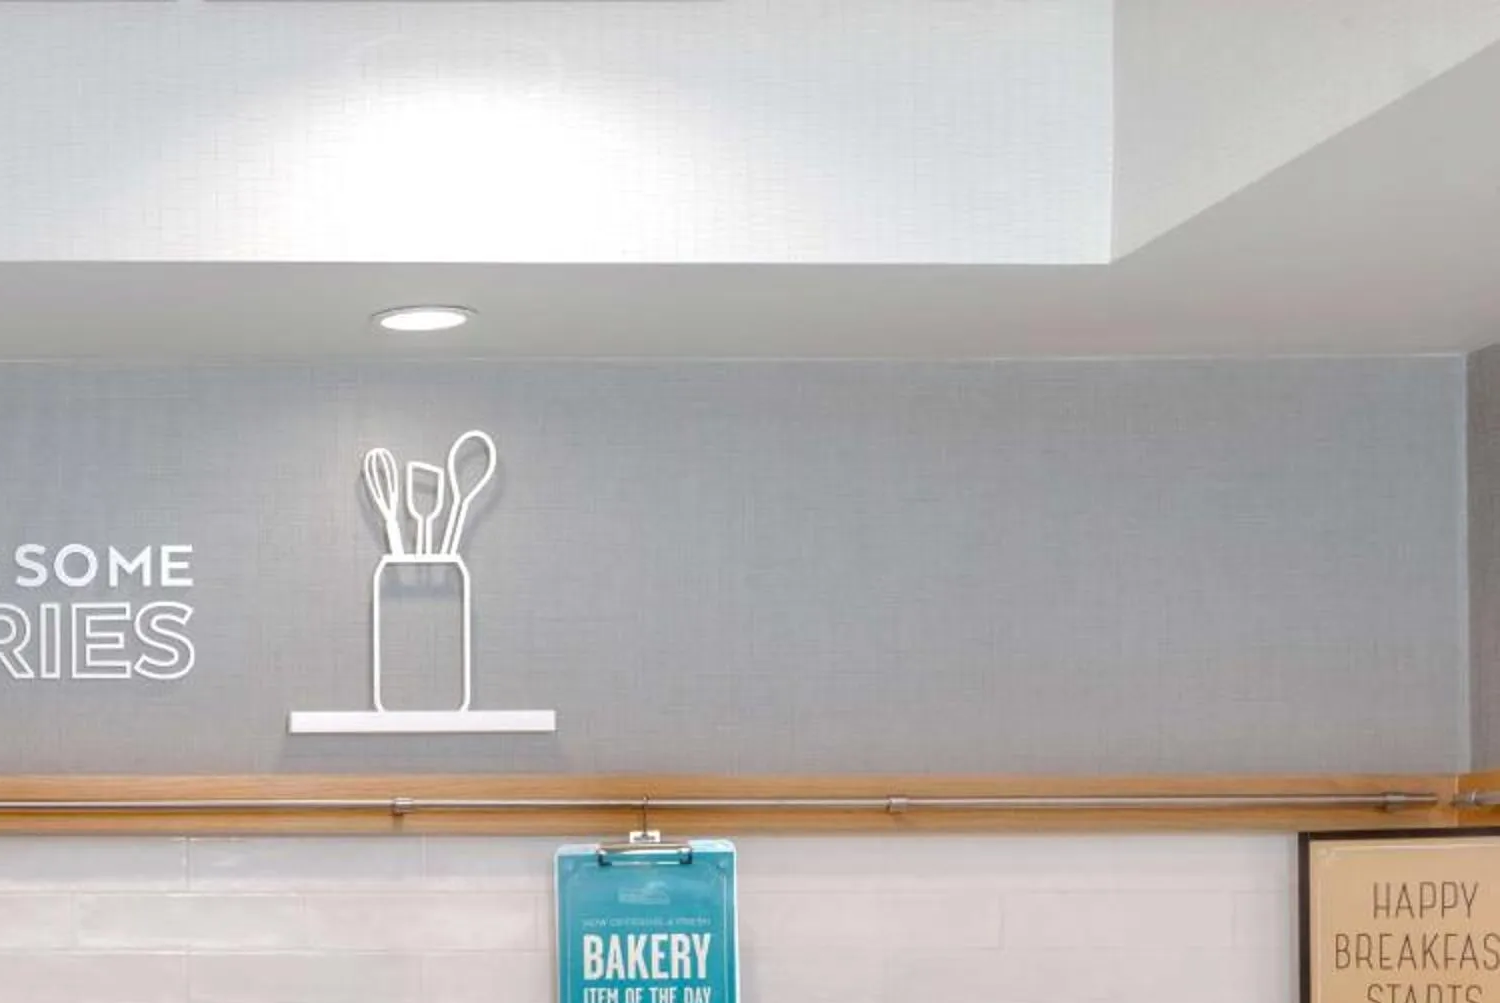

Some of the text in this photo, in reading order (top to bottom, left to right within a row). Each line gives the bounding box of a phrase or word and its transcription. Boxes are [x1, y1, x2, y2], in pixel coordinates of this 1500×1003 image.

[16, 543, 194, 588] SOME
[1373, 881, 1480, 919] HAPPY
[583, 934, 712, 981] BAKERY
